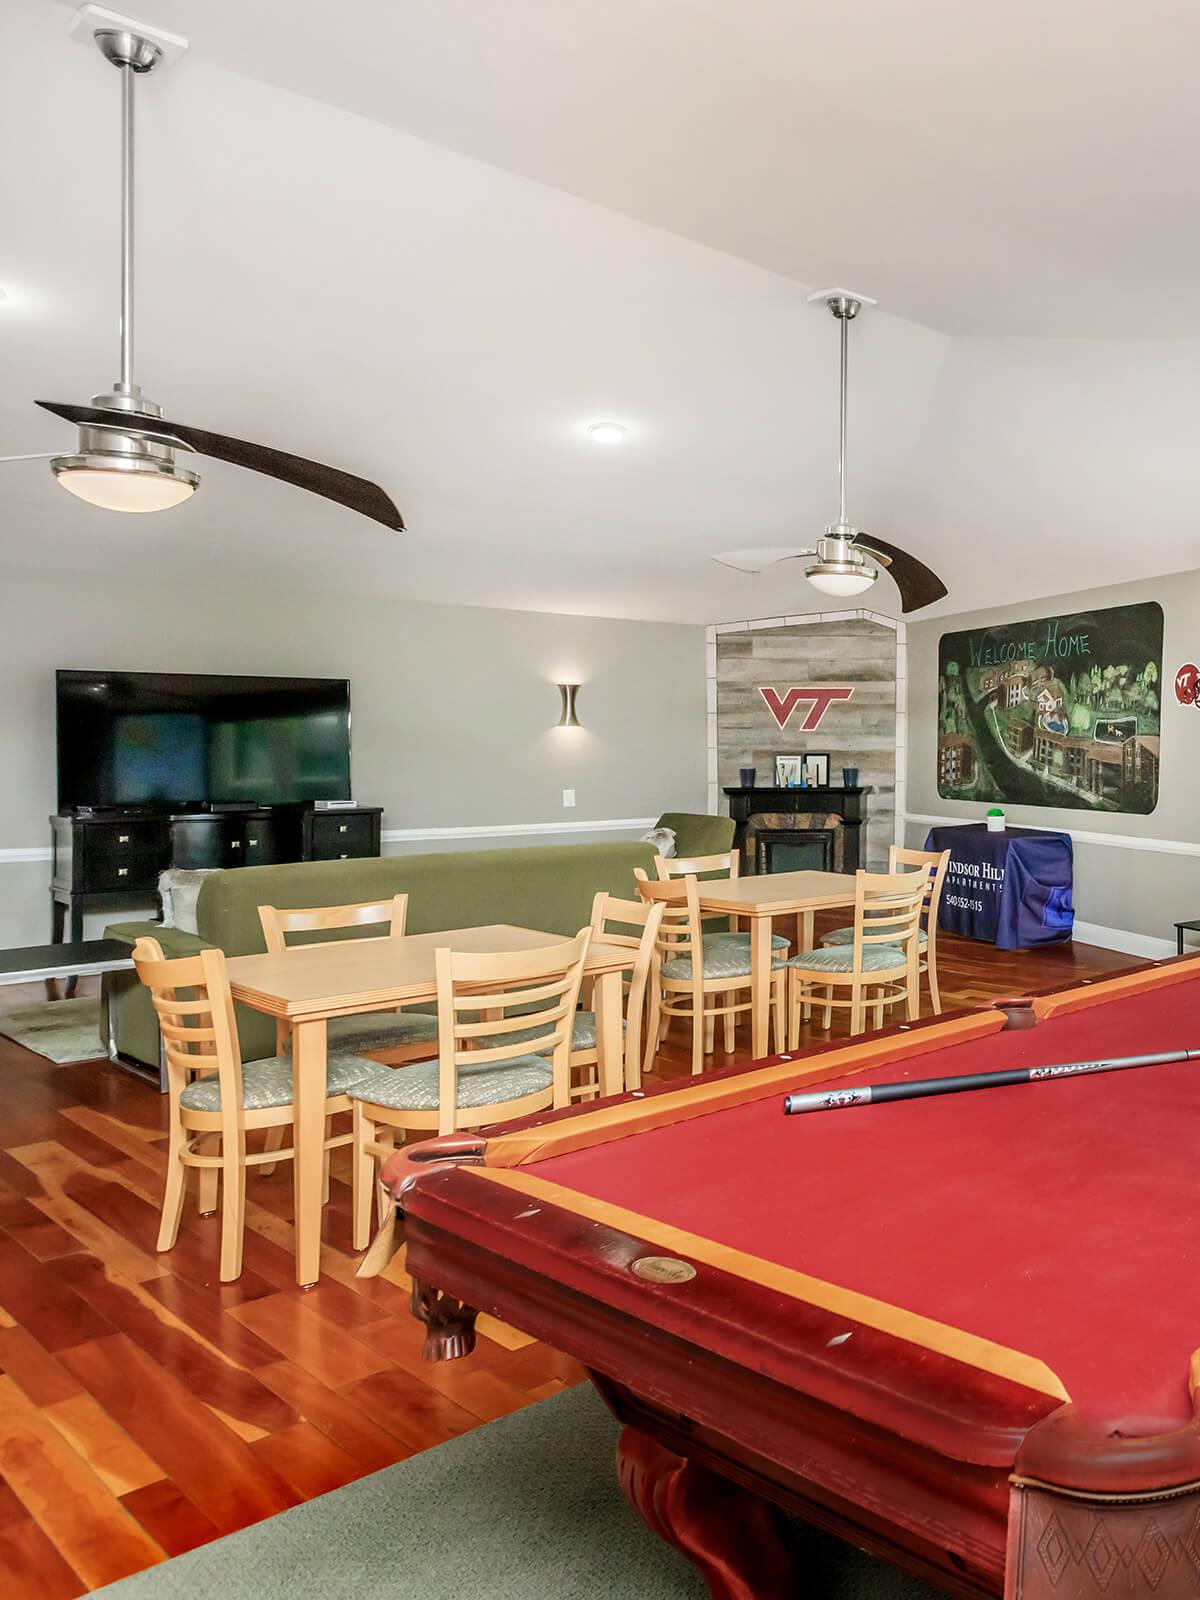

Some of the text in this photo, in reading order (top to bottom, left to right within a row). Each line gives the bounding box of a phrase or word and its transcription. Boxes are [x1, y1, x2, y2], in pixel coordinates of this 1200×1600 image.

[968, 619, 1092, 667] WELCOME HOME
[1177, 673, 1191, 687] VT
[758, 686, 856, 732] VT
[948, 861, 980, 877] INDSOR
